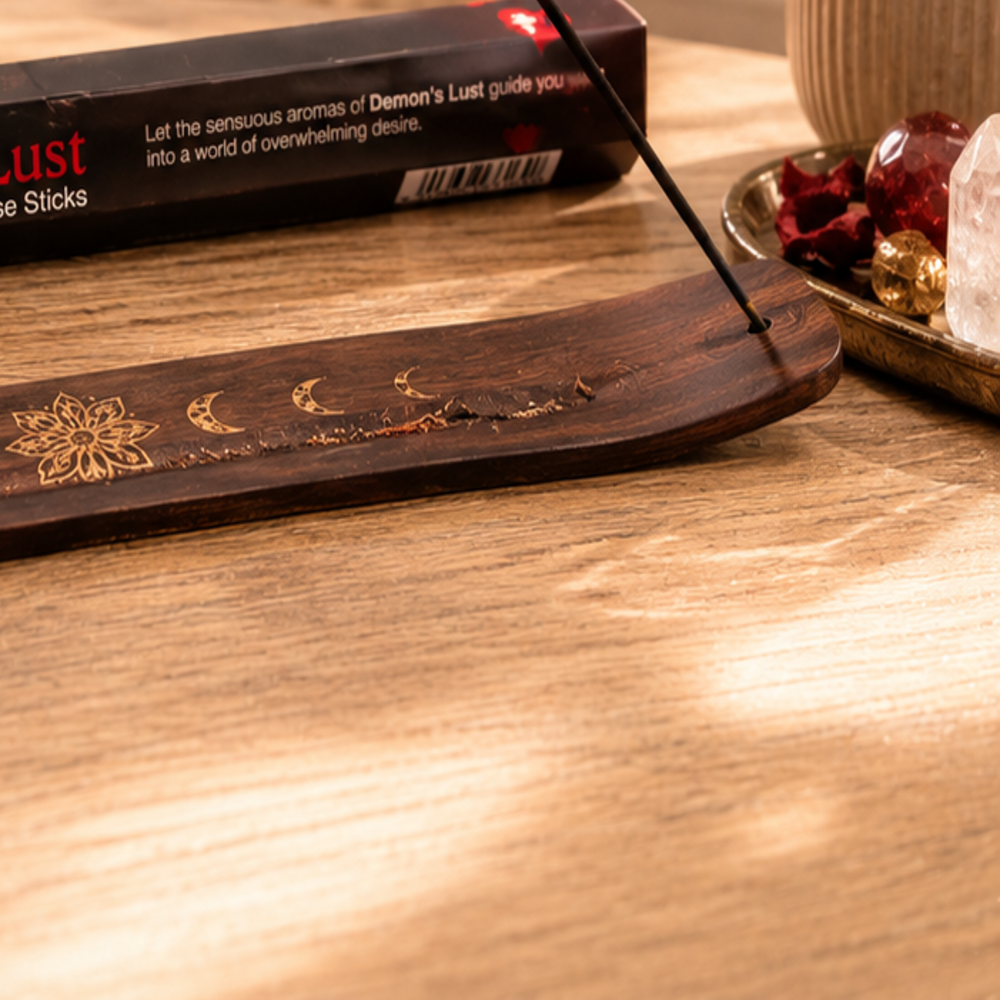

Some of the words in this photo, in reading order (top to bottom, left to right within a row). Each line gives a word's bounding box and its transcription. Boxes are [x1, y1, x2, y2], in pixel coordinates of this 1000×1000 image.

[145, 123, 171, 142] Let
[175, 119, 201, 138] the
[205, 110, 282, 134] sensuous
[286, 101, 346, 123] aromas
[350, 94, 366, 115] of
[369, 86, 444, 112] Demon's
[449, 81, 484, 102] Lust
[489, 75, 532, 100] guide
[535, 74, 565, 95] you
[146, 149, 176, 167] into
[180, 148, 191, 164] a
[194, 138, 238, 161] world
[241, 134, 258, 154] of
[260, 123, 368, 152] overwhelming
[371, 116, 422, 136] desire.
[24, 186, 88, 213] Sticks
